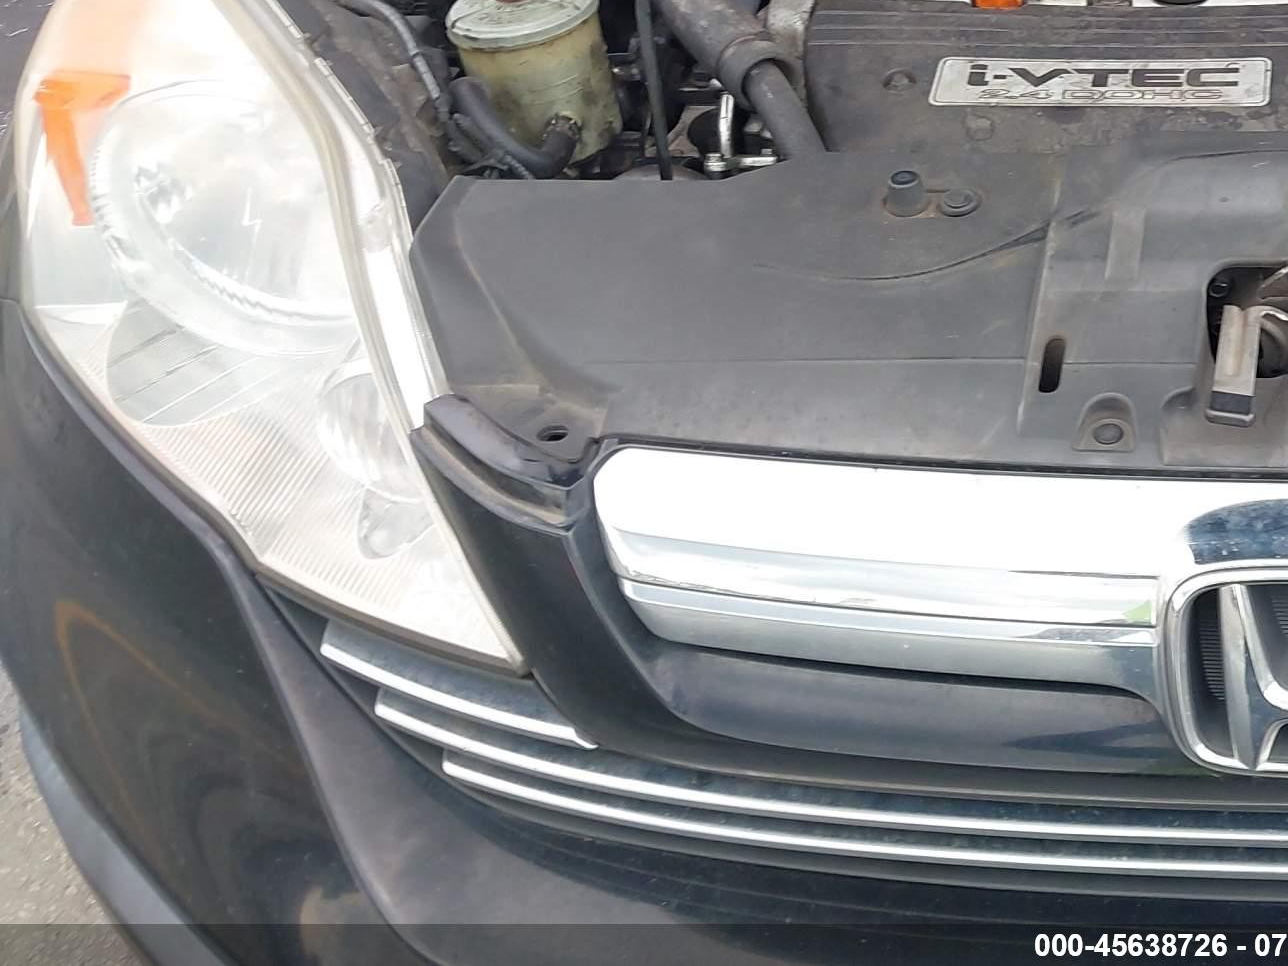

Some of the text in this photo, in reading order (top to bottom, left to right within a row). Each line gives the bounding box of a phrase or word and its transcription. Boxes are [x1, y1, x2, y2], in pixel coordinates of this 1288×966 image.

[967, 63, 1240, 88] i-VTEC
[979, 89, 1223, 101] 2.4 DOHC
